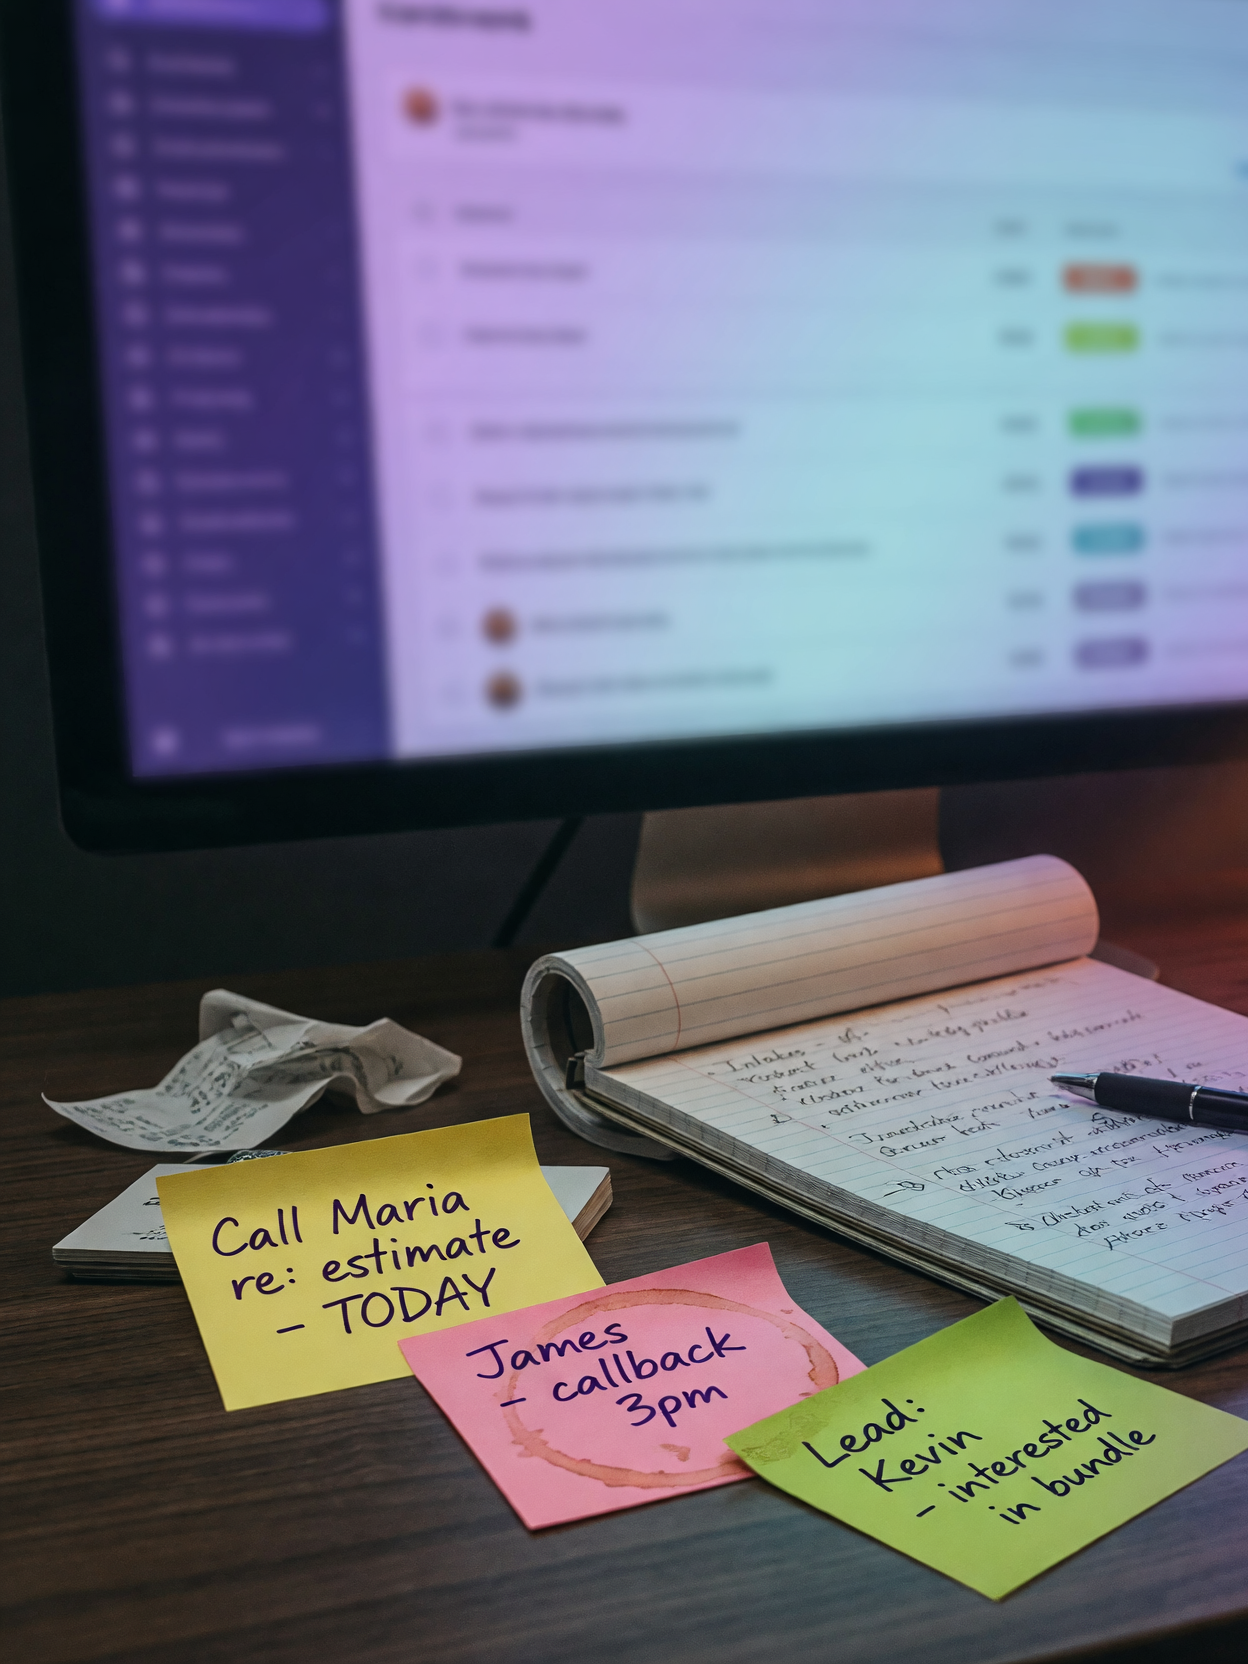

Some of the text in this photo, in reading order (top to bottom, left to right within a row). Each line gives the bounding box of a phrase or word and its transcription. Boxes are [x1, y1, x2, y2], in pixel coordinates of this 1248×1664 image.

[212, 1205, 303, 1257] Call
[332, 1183, 470, 1235] Maria
[231, 1218, 521, 1301] re: estimate
[322, 1267, 496, 1334] TODAY
[465, 1322, 628, 1380] James
[552, 1326, 747, 1402] callback
[615, 1385, 728, 1428] 3pm
[801, 1398, 926, 1469] Lead:
[858, 1430, 983, 1493] Kevin
[937, 1398, 1113, 1503] interested
[990, 1430, 1157, 1525] in bundle
